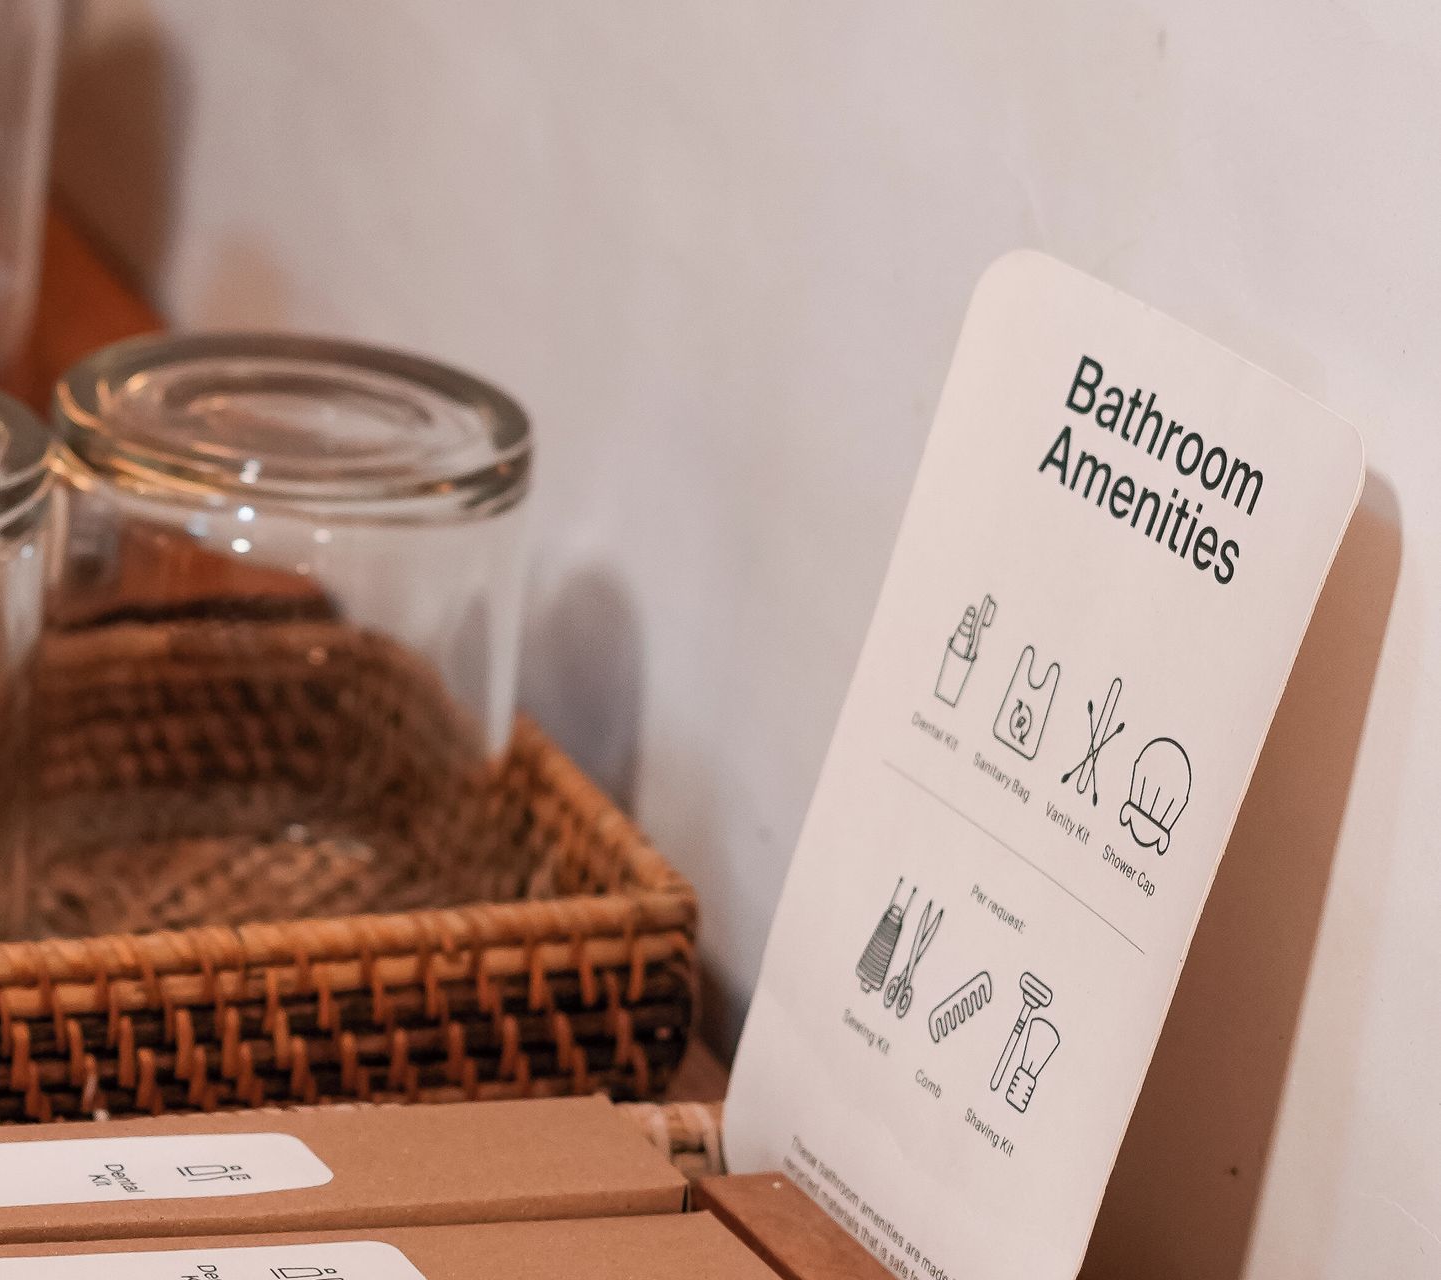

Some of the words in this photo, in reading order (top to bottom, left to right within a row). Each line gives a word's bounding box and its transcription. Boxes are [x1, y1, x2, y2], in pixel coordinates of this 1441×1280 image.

[1064, 354, 1264, 516] Bathroom
[1037, 425, 1241, 585] Amenities
[911, 711, 943, 742] Dental
[944, 729, 960, 752] Kit
[972, 751, 1010, 789] Sanitary
[1010, 777, 1031, 805] Bag
[1045, 801, 1075, 836] Vanity
[1075, 822, 1090, 845] Kit
[1102, 844, 1137, 881] Shower
[1137, 872, 1156, 897] Cap
[970, 884, 988, 907] Per
[988, 900, 1027, 934] request:
[842, 1008, 876, 1048] Sewing
[876, 1031, 891, 1056] Kit
[915, 1068, 943, 1100] Comb
[965, 1107, 998, 1148] Shaving
[999, 1133, 1015, 1158] Kit
[88, 1174, 112, 1187] Kit
[104, 1163, 145, 1193] Dental
[818, 1161, 859, 1206] bathroom
[860, 1201, 905, 1248] amenities
[905, 1241, 921, 1263] are
[820, 1189, 859, 1235] materials
[860, 1224, 879, 1252] that
[879, 1241, 888, 1261] is
[888, 1252, 910, 1280] safe
